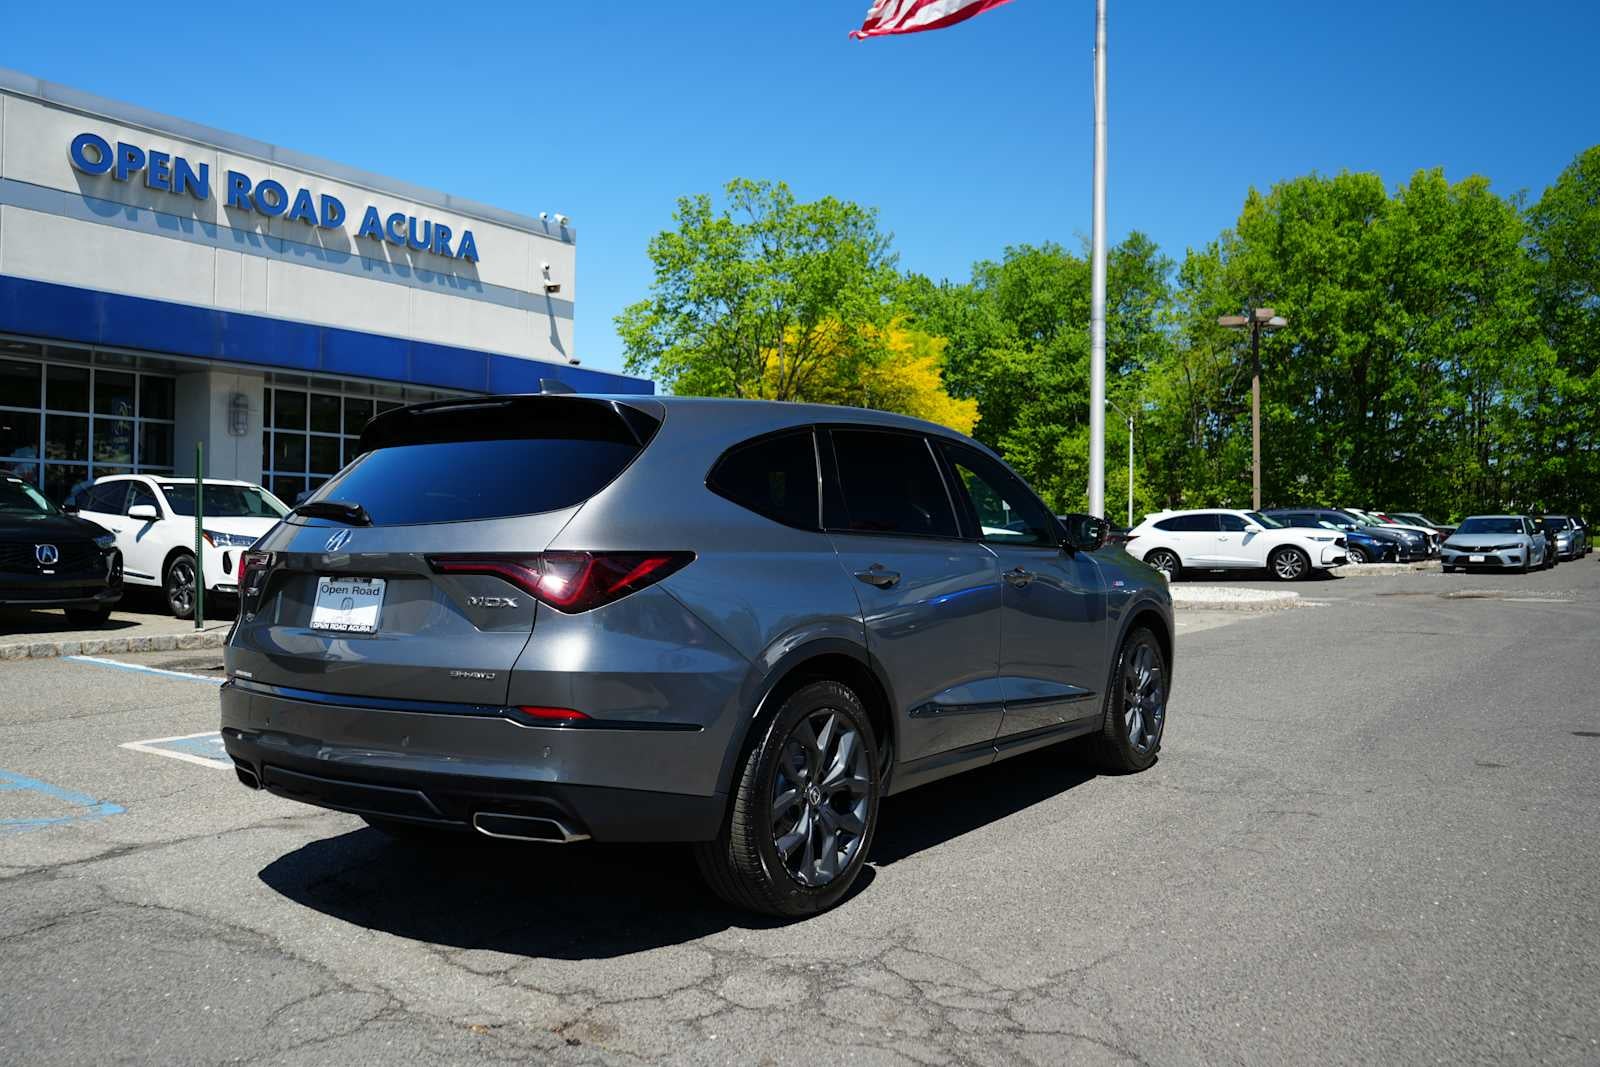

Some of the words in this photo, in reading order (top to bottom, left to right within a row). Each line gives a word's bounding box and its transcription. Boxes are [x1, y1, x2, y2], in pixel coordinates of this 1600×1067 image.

[69, 132, 209, 200] OPEN
[225, 169, 346, 229] ROAD
[356, 205, 479, 263] ACURA
[321, 584, 348, 596] Open
[352, 586, 380, 596] Road
[466, 596, 519, 608] MDX
[312, 621, 330, 630] OPEN
[330, 622, 348, 632] ROAD
[347, 624, 372, 633] ACURA
